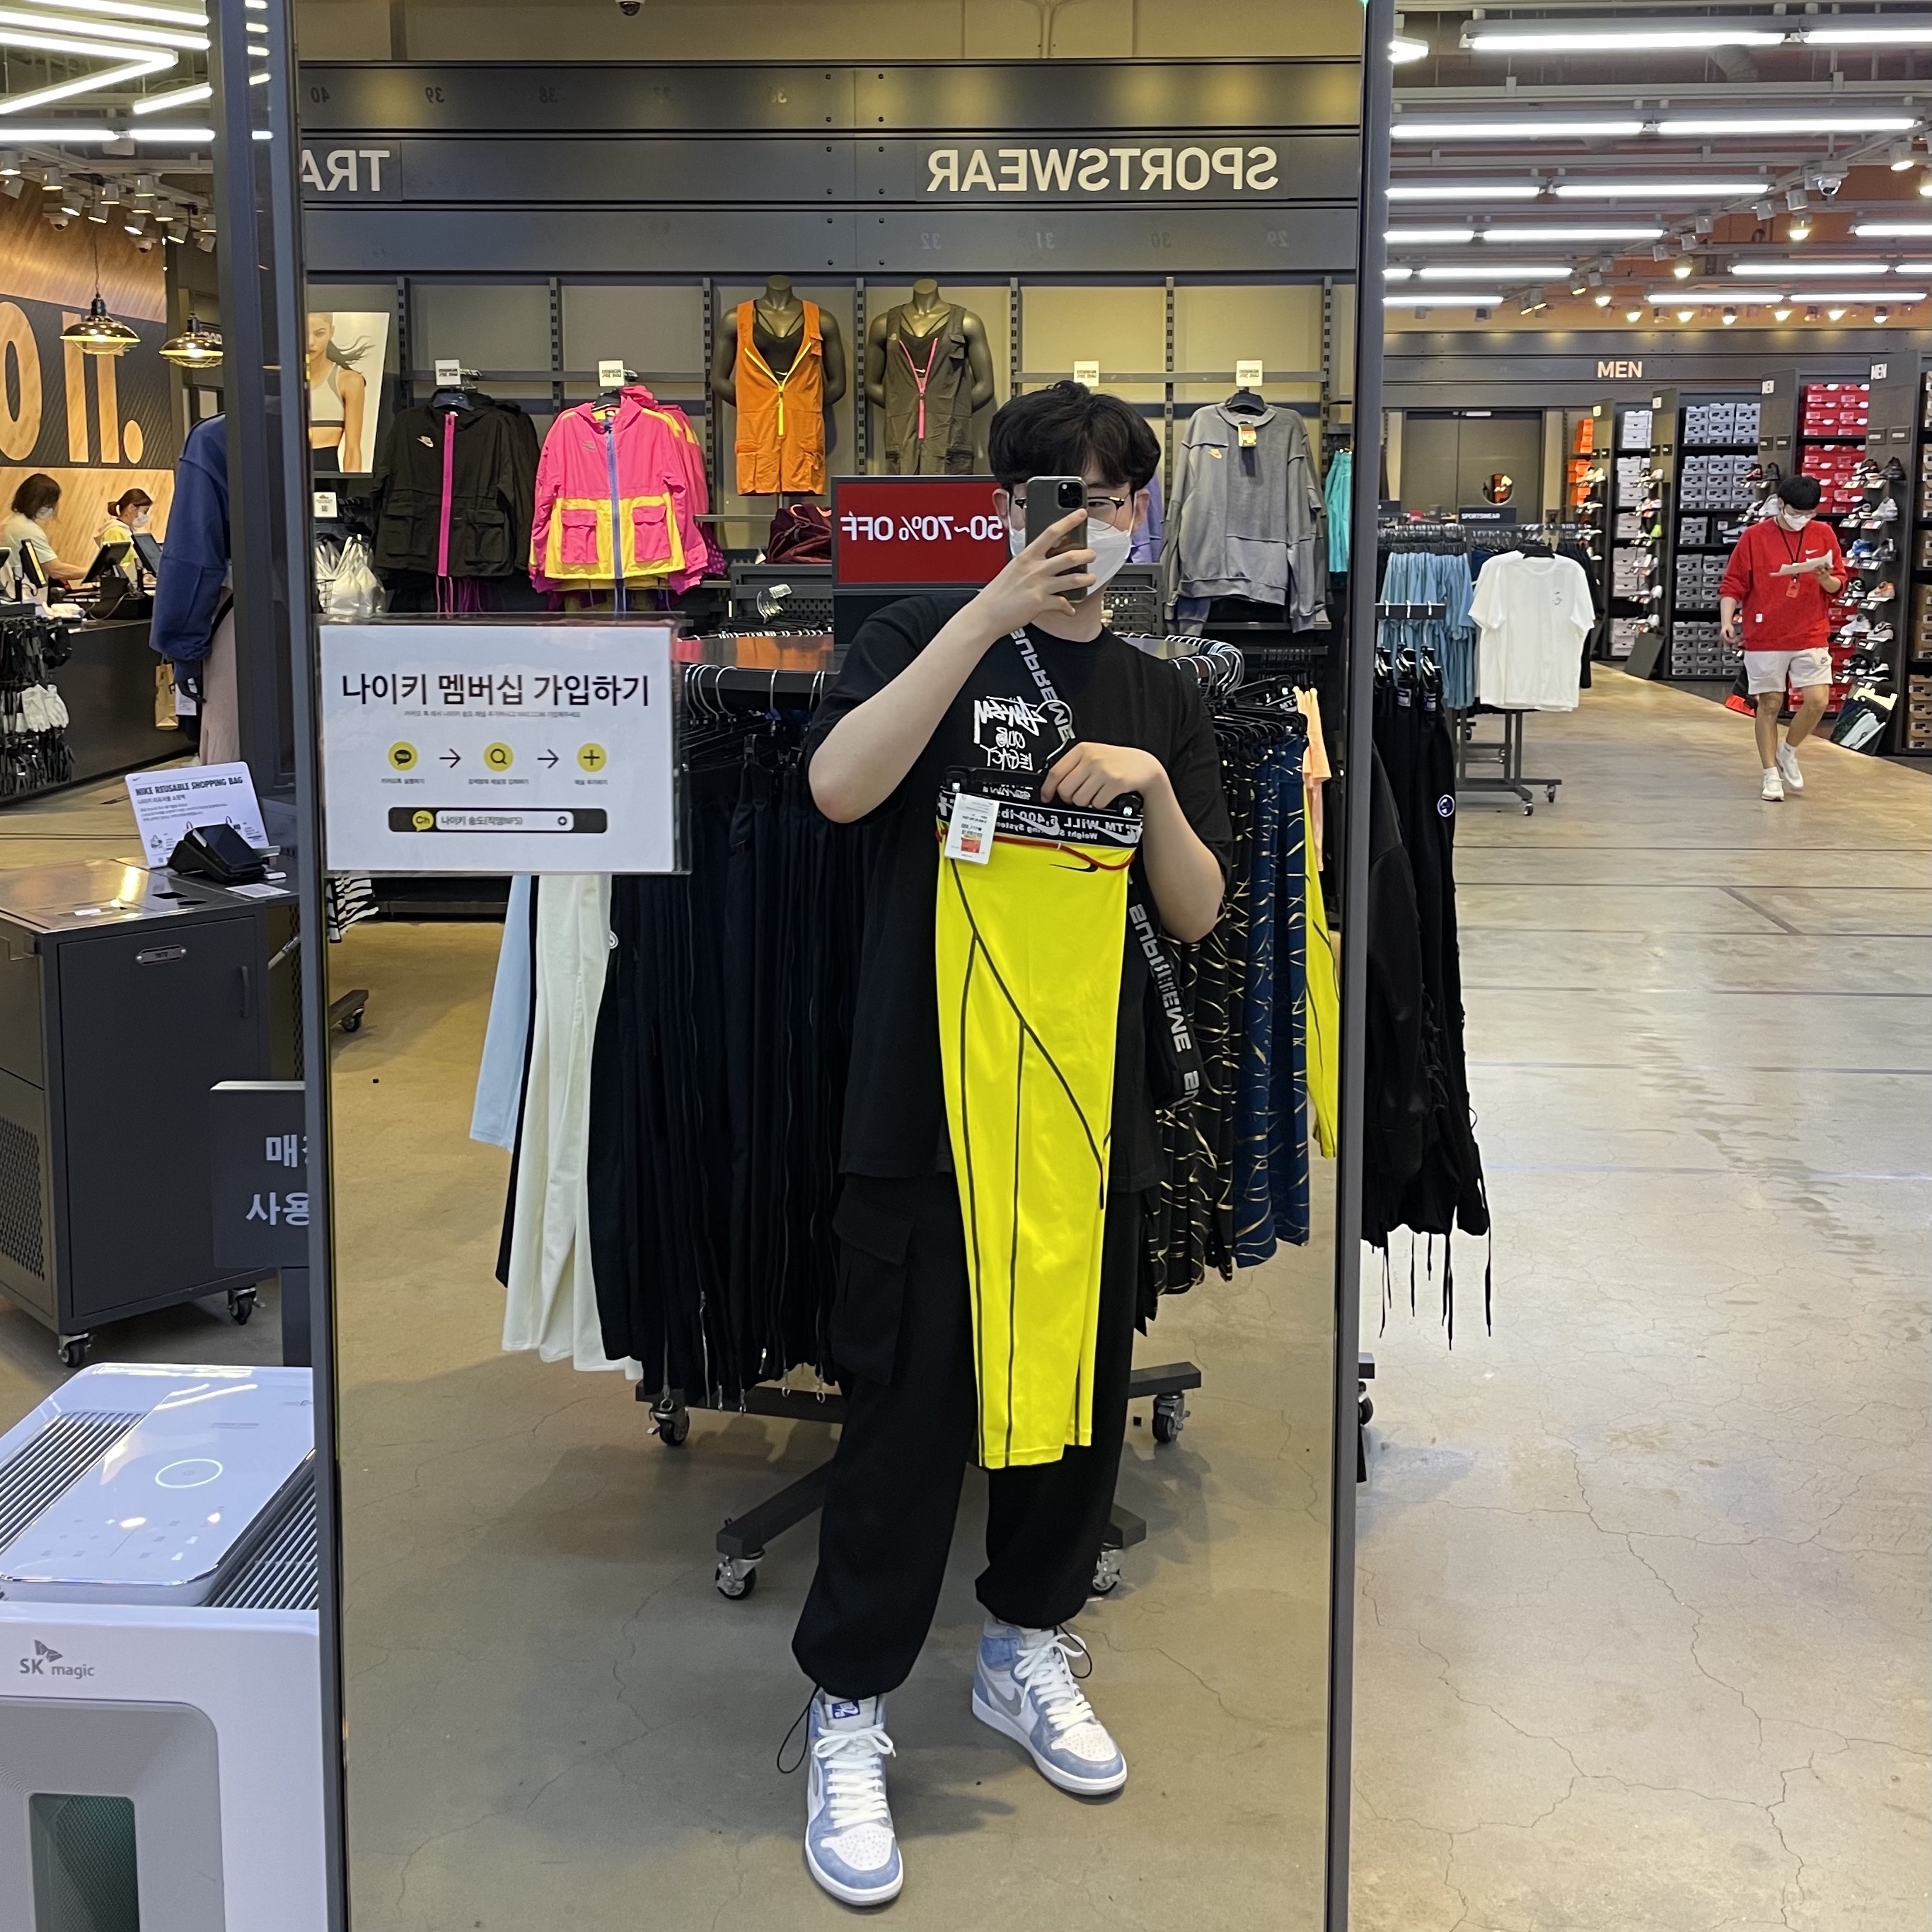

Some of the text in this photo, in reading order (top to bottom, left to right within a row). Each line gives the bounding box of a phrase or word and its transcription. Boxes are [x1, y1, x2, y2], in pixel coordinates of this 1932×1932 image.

[1597, 361, 1643, 378] MEN
[342, 673, 649, 706] 나이키 멤버십 가입하기
[135, 776, 243, 796] NIKE REUSABLE SHOPPING BAG
[441, 816, 466, 826] 나이키
[20, 1658, 96, 1679] SK magic
